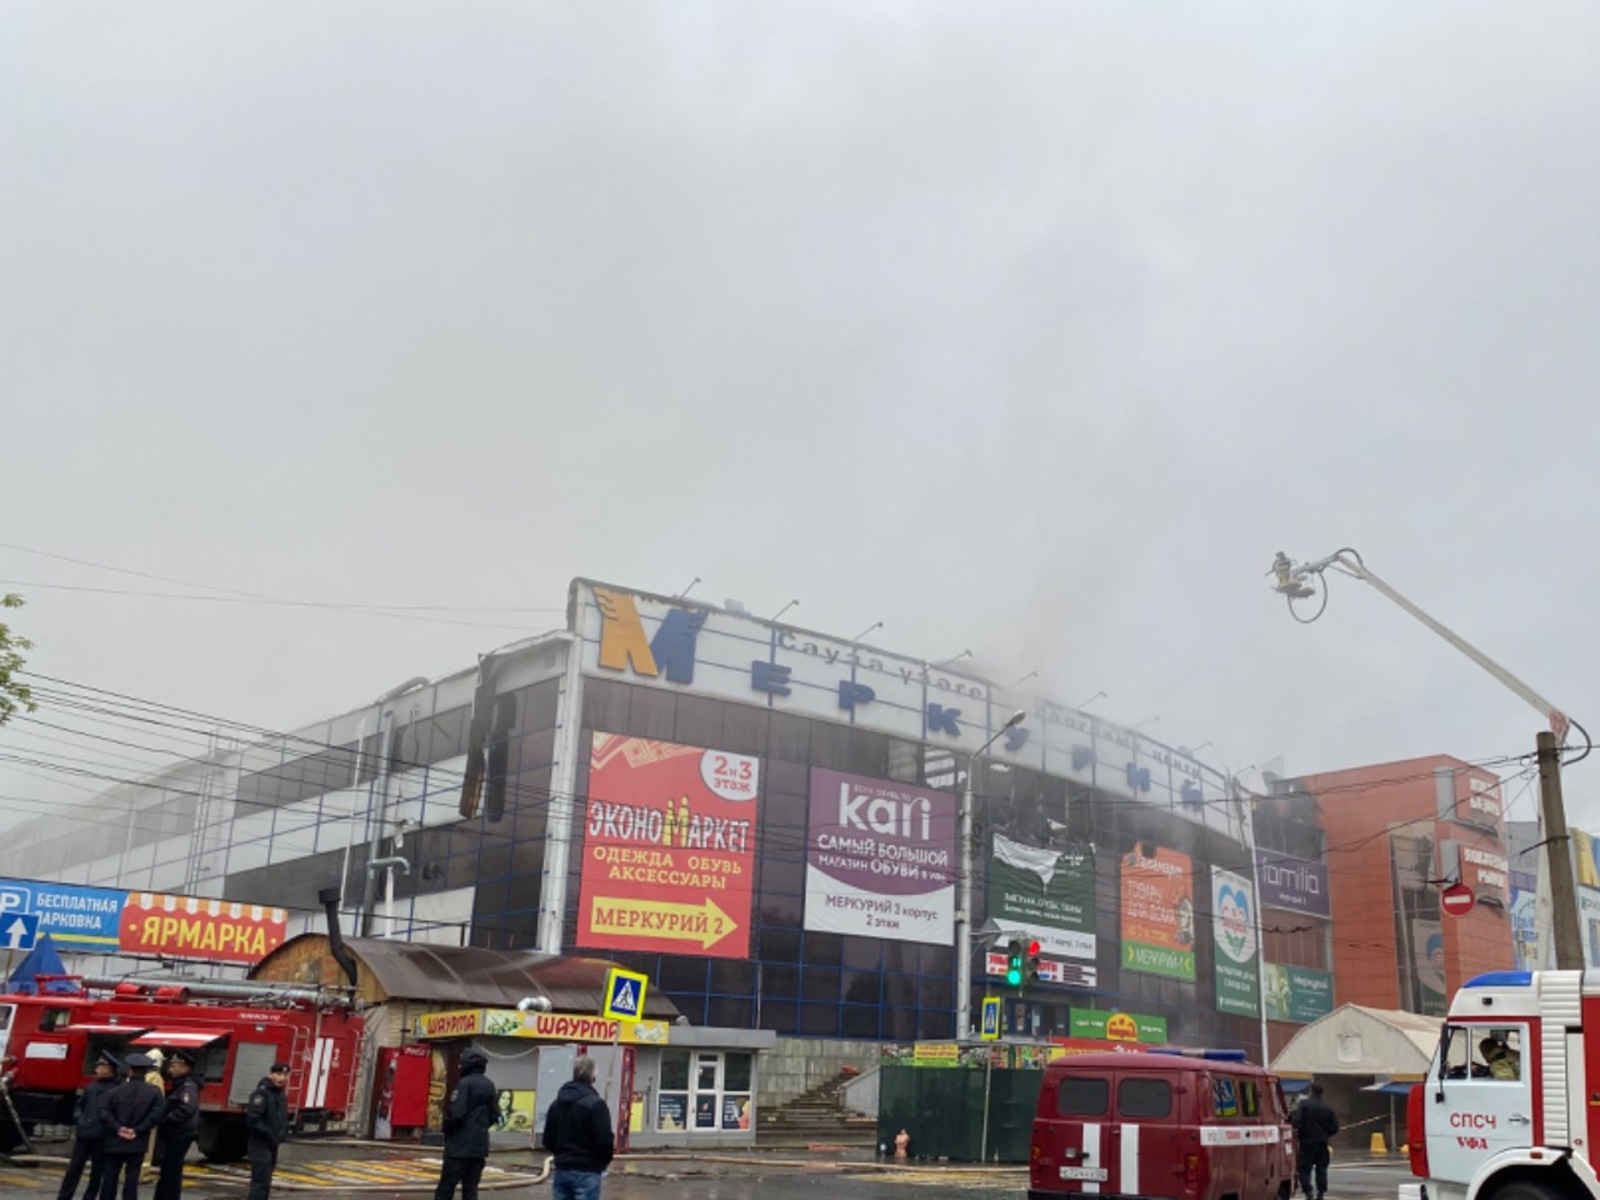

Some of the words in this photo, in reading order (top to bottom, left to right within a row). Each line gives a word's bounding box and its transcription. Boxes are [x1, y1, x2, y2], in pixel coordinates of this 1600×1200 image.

[714, 756, 728, 776] 2
[739, 761, 753, 780] 3
[713, 778, 751, 793] этаж
[839, 782, 932, 841] kari
[588, 796, 750, 854] ЭКОНОМАРКЕТ
[593, 846, 675, 868] ОДЕЖДА
[687, 856, 742, 875] ОБУВЬ
[817, 833, 876, 856] САМЫЙ
[878, 841, 948, 867] БОЛЬШОЙ
[608, 866, 727, 890] АКСЕССУАРЫ
[819, 855, 868, 872] МАГАЗИН
[870, 858, 920, 880] ОБУВИ
[36, 892, 118, 914] БЕСПЛАТНАЯ
[825, 894, 892, 914] МЕРКУРИЙ
[902, 907, 938, 921] корпус
[595, 907, 709, 934] МЕРКУРИЙ
[713, 918, 724, 935] 2
[140, 915, 266, 955] ЯРМАРКА
[427, 1014, 475, 1035] ШАУРМА
[1449, 1112, 1496, 1130] СПСЧ
[1457, 1136, 1489, 1150] УФА
